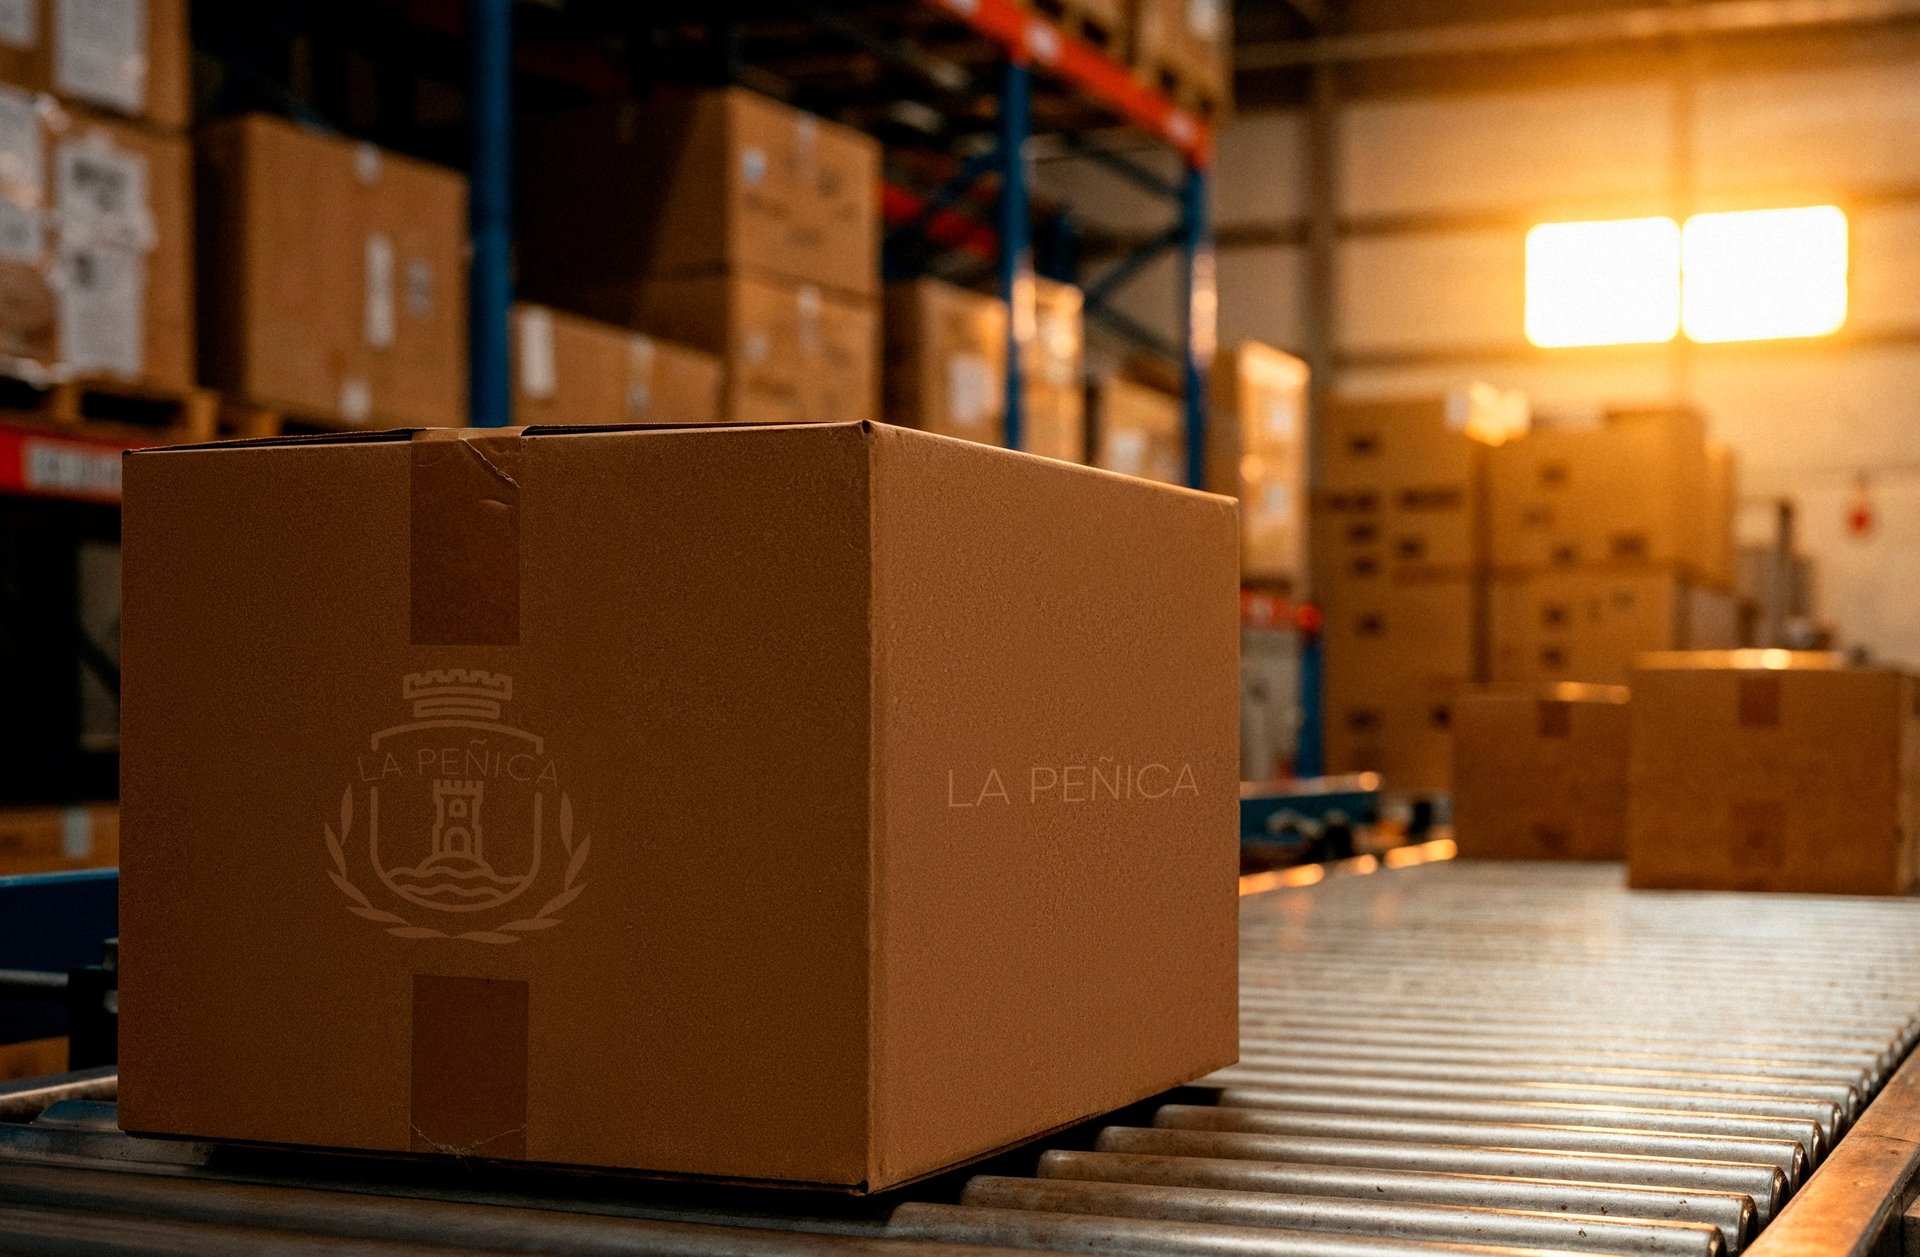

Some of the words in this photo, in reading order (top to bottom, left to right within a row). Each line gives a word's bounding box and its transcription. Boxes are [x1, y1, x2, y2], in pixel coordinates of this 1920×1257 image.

[357, 751, 403, 782] LA
[417, 739, 558, 788] PEÑICA
[949, 768, 1011, 808] LA
[1030, 755, 1200, 804] PEÑICA
